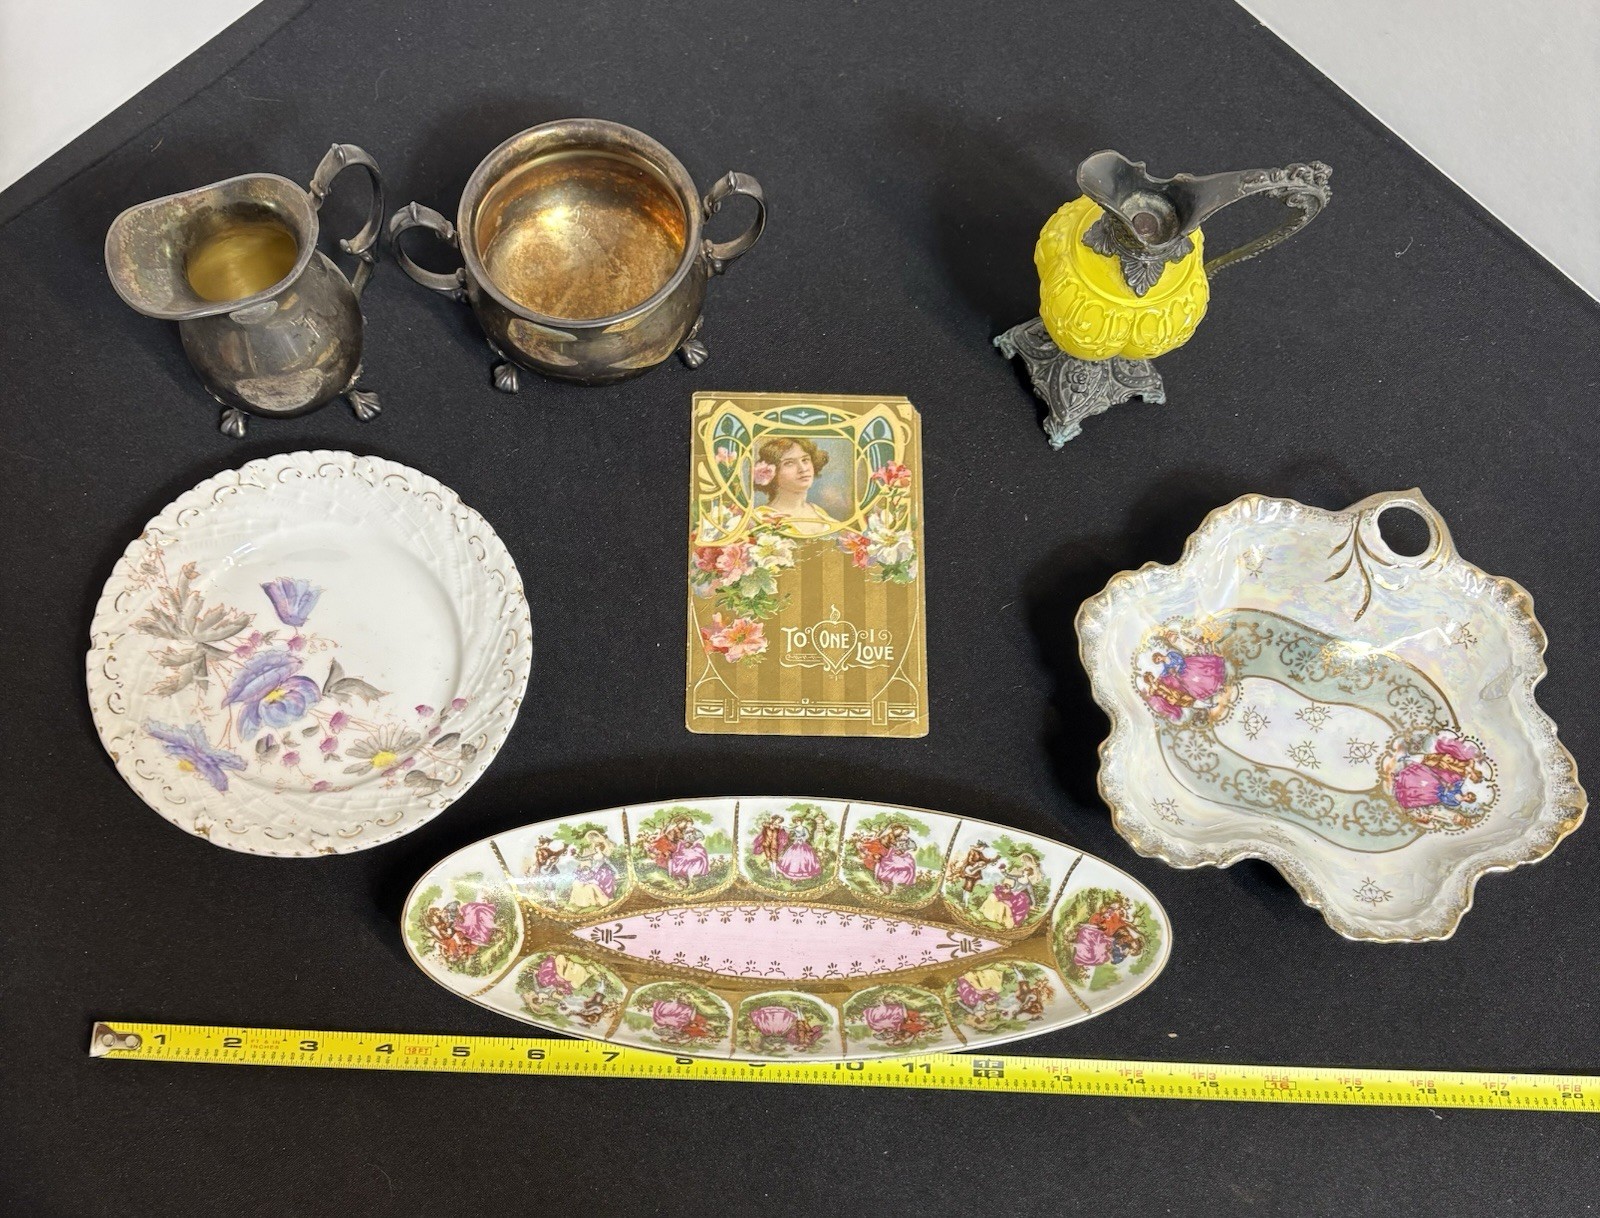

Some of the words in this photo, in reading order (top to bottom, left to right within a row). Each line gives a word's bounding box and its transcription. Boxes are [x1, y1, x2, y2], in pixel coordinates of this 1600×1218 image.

[781, 627, 807, 653] TO
[819, 630, 850, 649] ONE
[856, 642, 894, 664] LOVE
[154, 1034, 166, 1045] 1
[223, 1037, 242, 1048] 2
[299, 1040, 318, 1052] 3
[375, 1043, 395, 1054] 4
[452, 1046, 471, 1057] 5
[527, 1049, 545, 1060] 6
[602, 1051, 620, 1062] 7
[835, 1061, 864, 1071] 10
[901, 1062, 931, 1074] 11
[978, 1070, 999, 1078] 12
